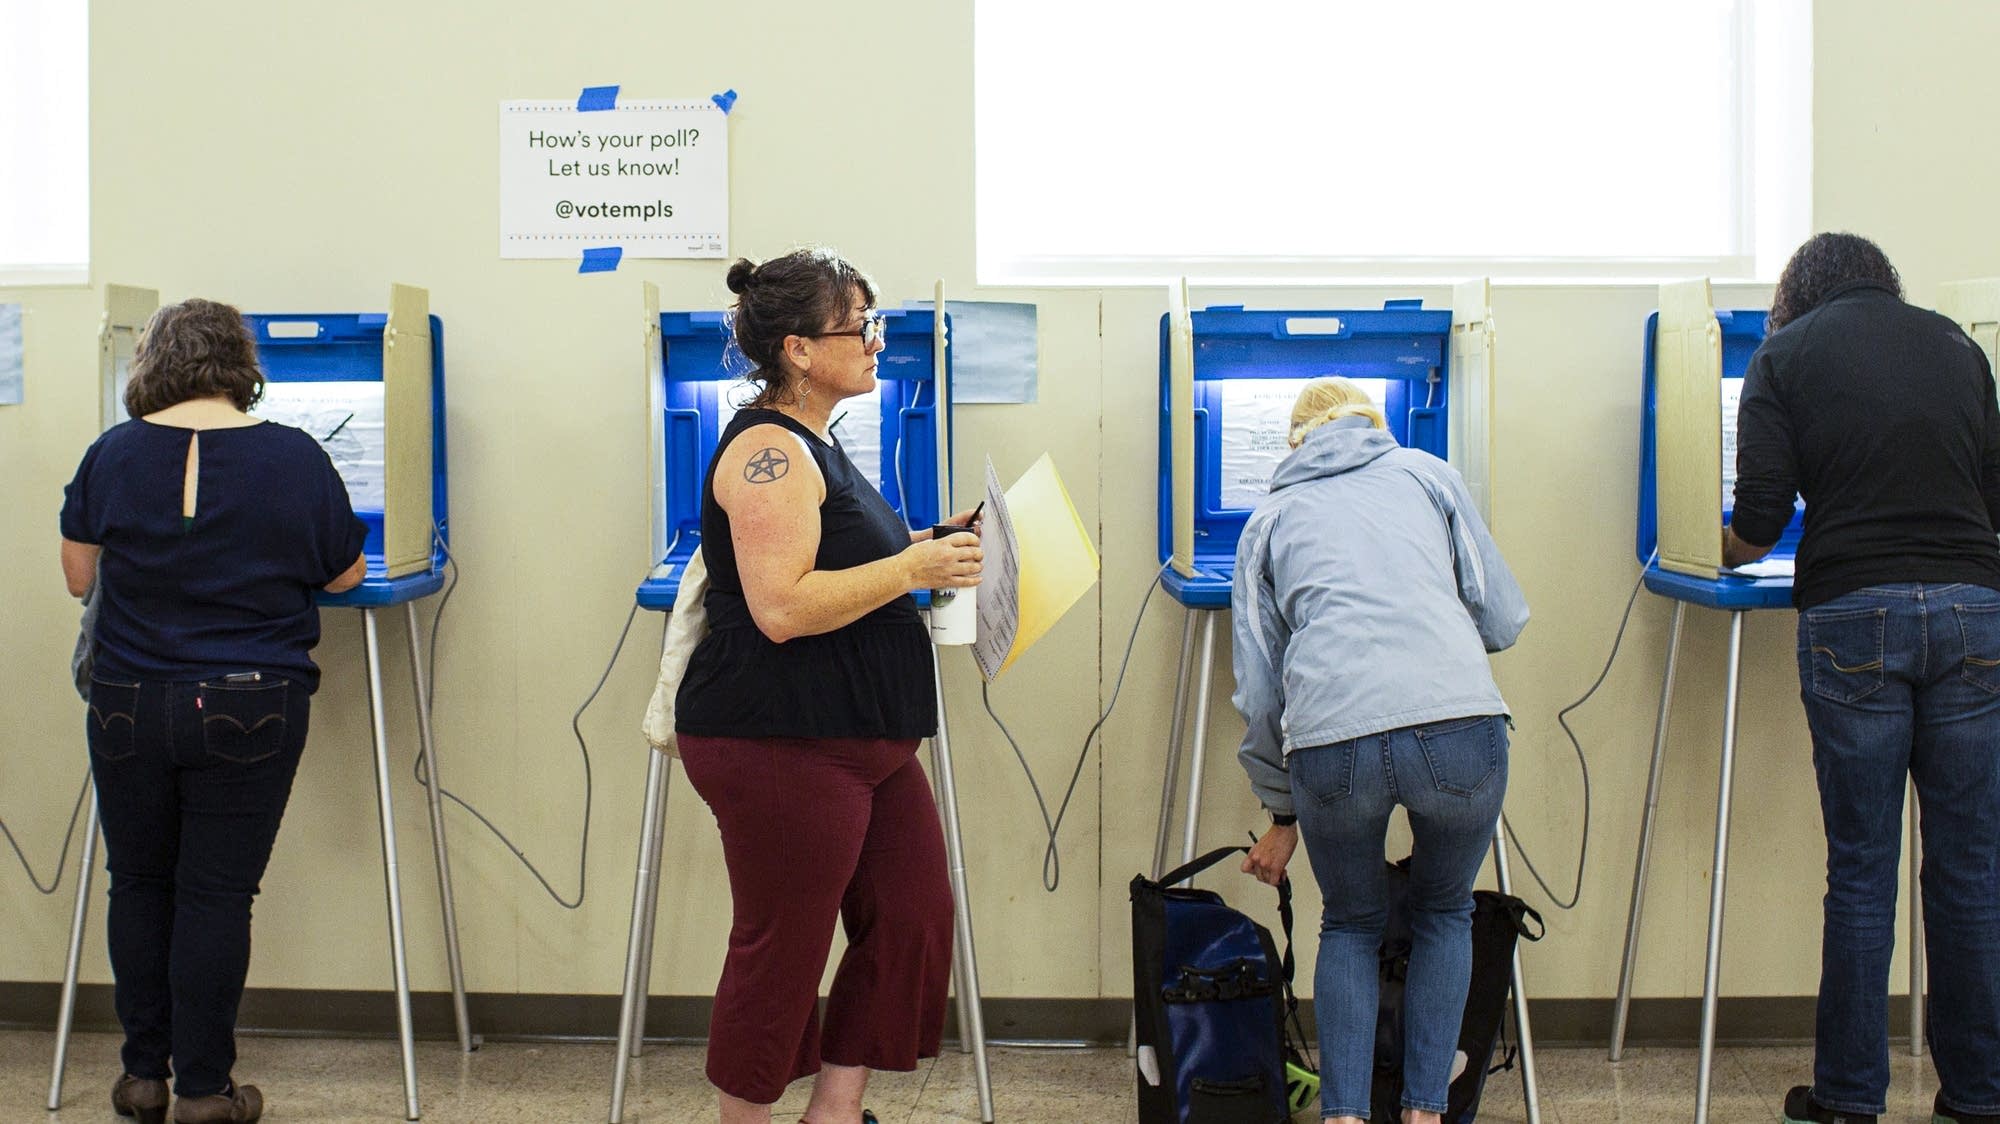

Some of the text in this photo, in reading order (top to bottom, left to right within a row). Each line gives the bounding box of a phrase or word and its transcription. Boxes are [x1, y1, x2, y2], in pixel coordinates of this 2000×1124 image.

[529, 128, 700, 153] How's your poll?
[549, 157, 680, 177] Let us know!
[555, 199, 674, 222] @votempls
